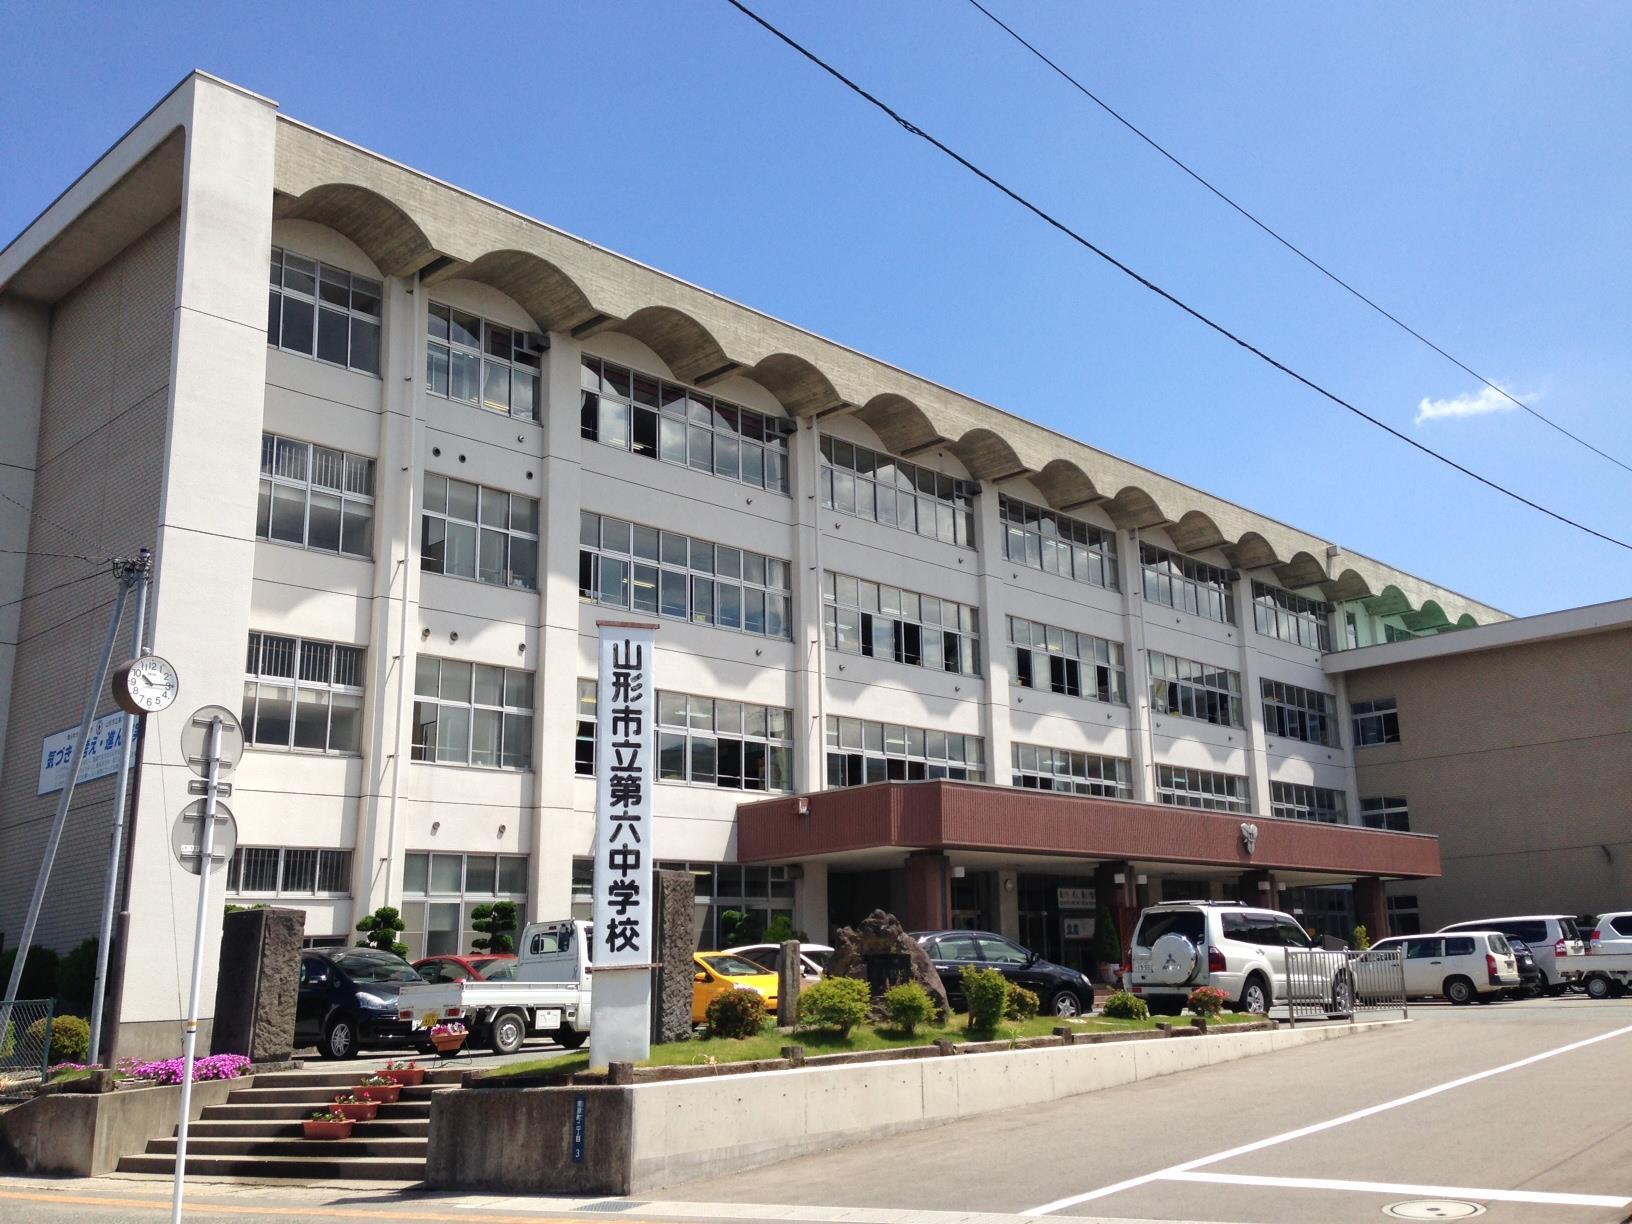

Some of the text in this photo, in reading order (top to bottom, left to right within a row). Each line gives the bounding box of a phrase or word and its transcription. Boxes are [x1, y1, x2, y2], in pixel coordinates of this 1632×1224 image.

[605, 638, 643, 953] 山形市立第六中学校
[575, 1149, 580, 1158] 3
